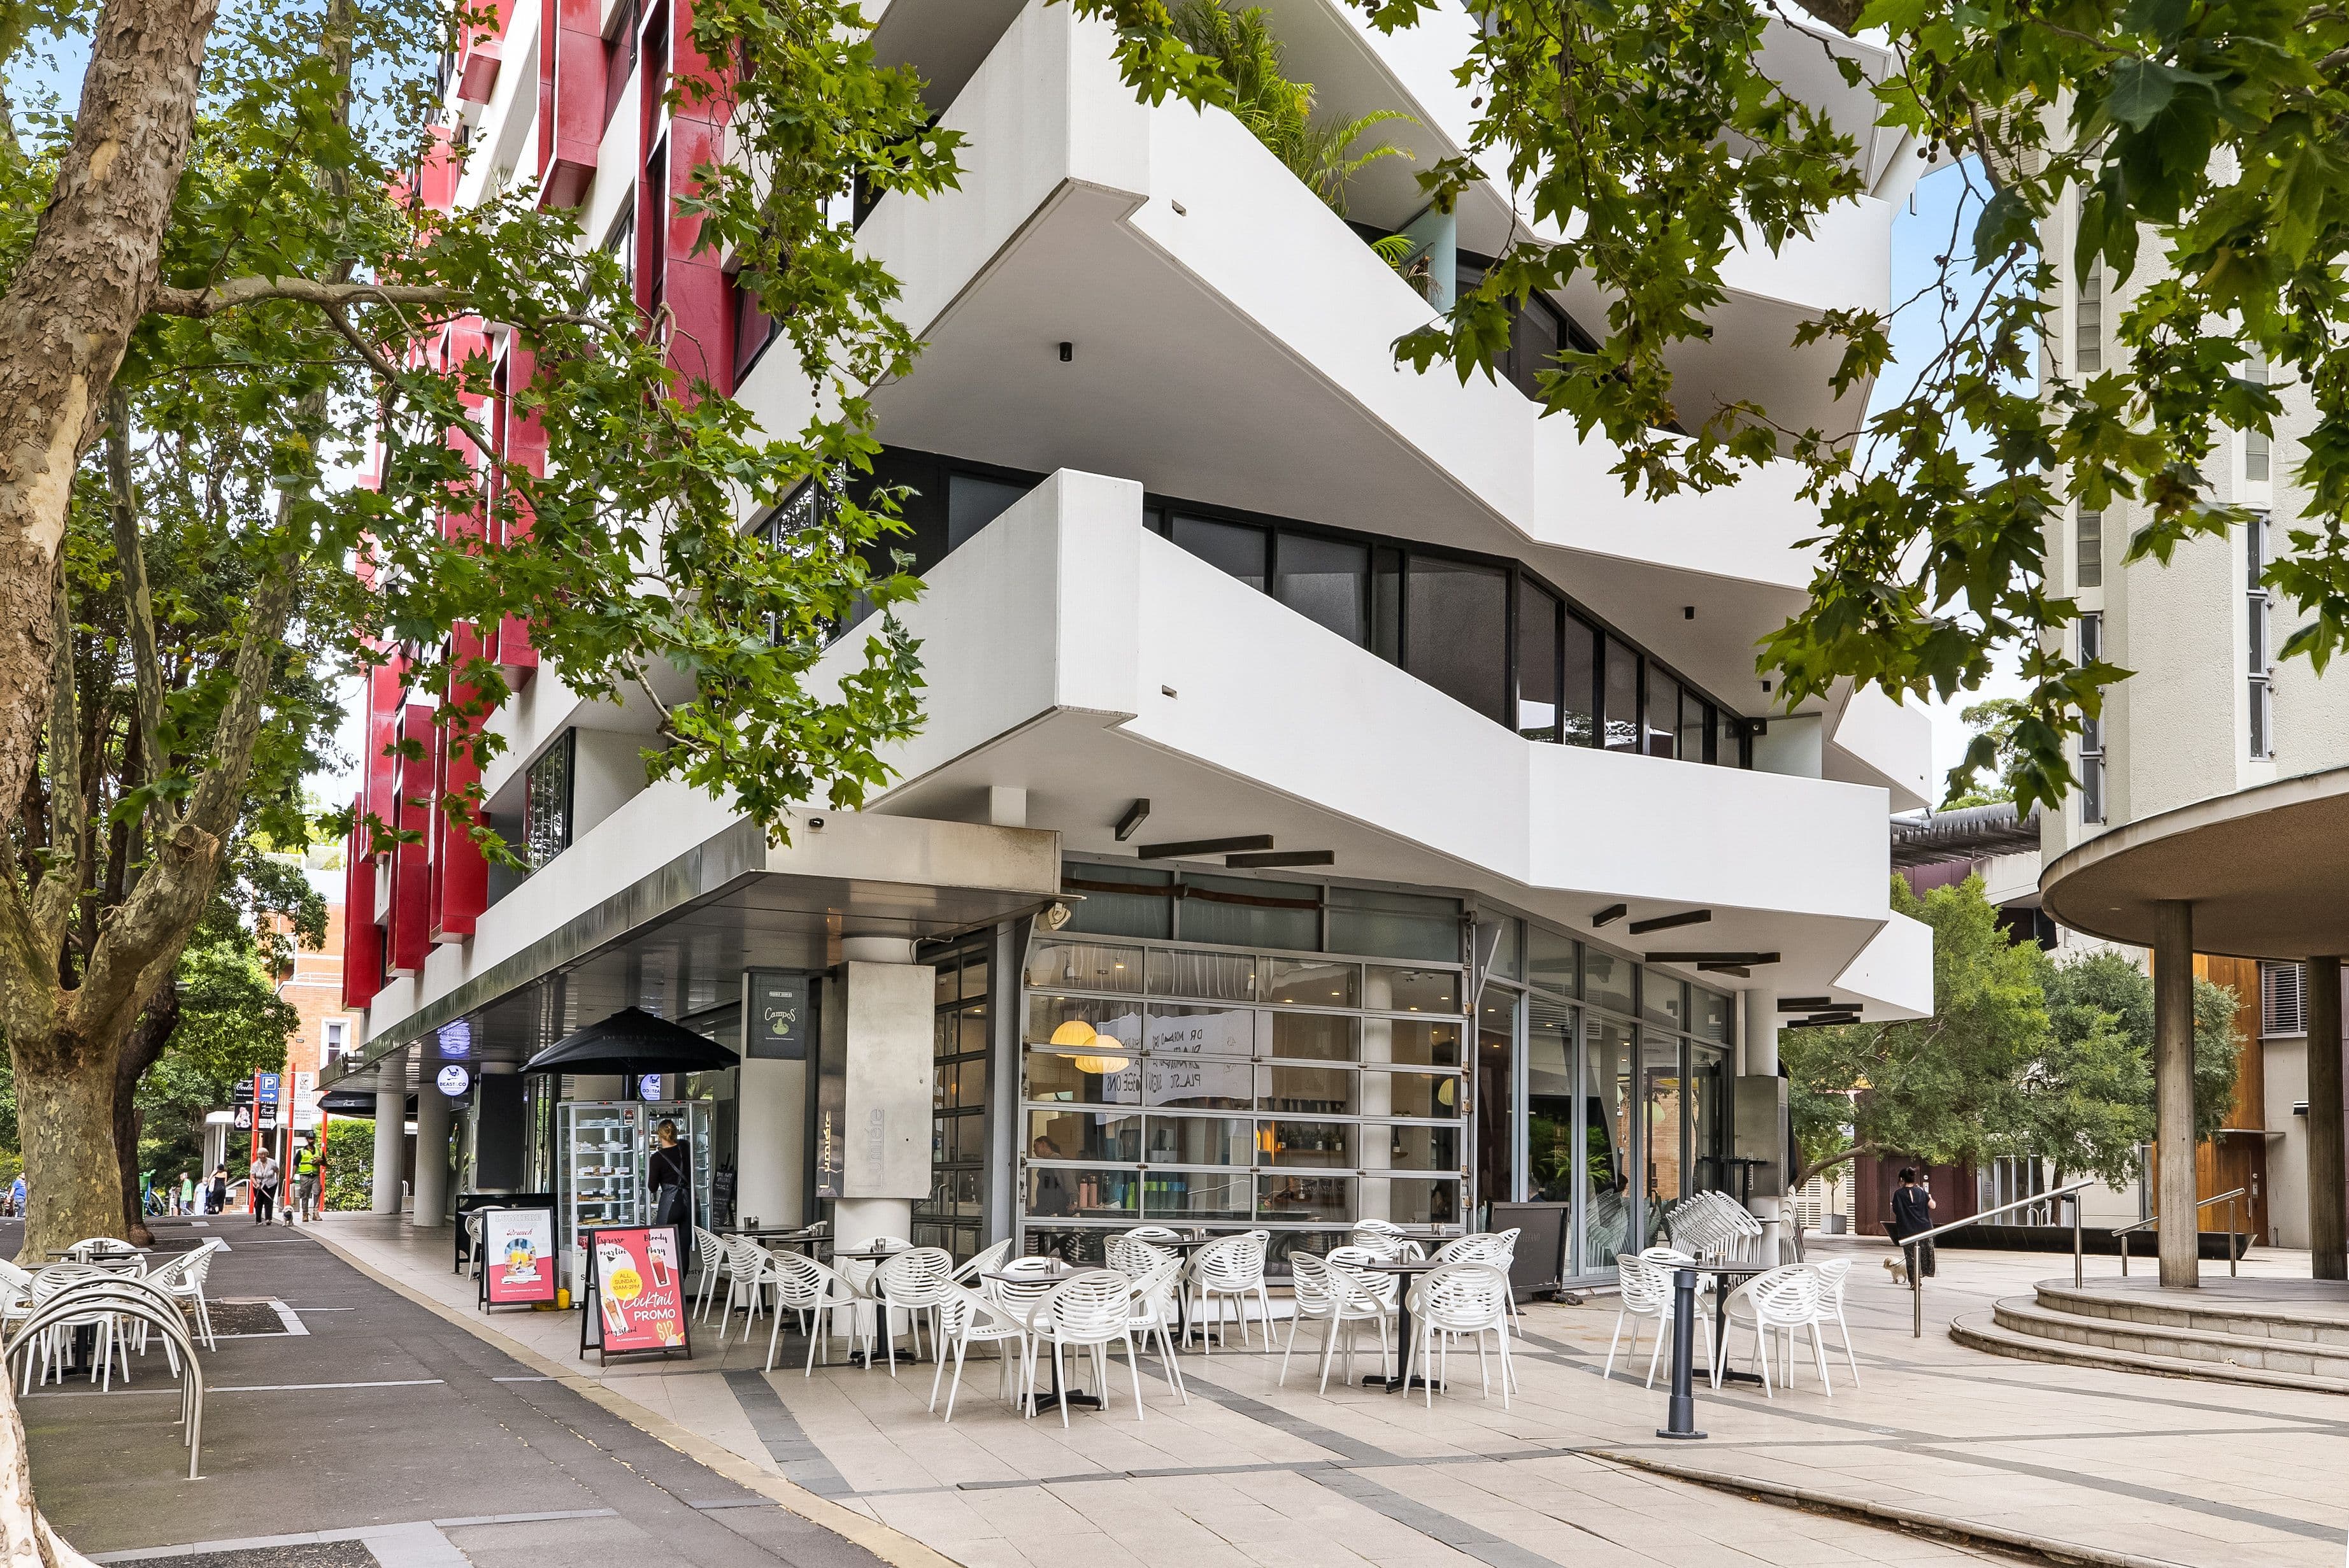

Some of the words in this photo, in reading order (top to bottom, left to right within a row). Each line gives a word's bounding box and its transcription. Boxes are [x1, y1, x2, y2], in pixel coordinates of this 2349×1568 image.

[765, 1007, 796, 1022] Campos
[264, 1078, 275, 1088] P
[506, 1228, 532, 1236] Brunch
[597, 1236, 625, 1246] Espresso
[644, 1233, 668, 1243] Bloody
[646, 1246, 666, 1256] Mary
[622, 1290, 675, 1309] Cocktail
[634, 1308, 676, 1322] PROMO
[656, 1320, 674, 1341] $12
